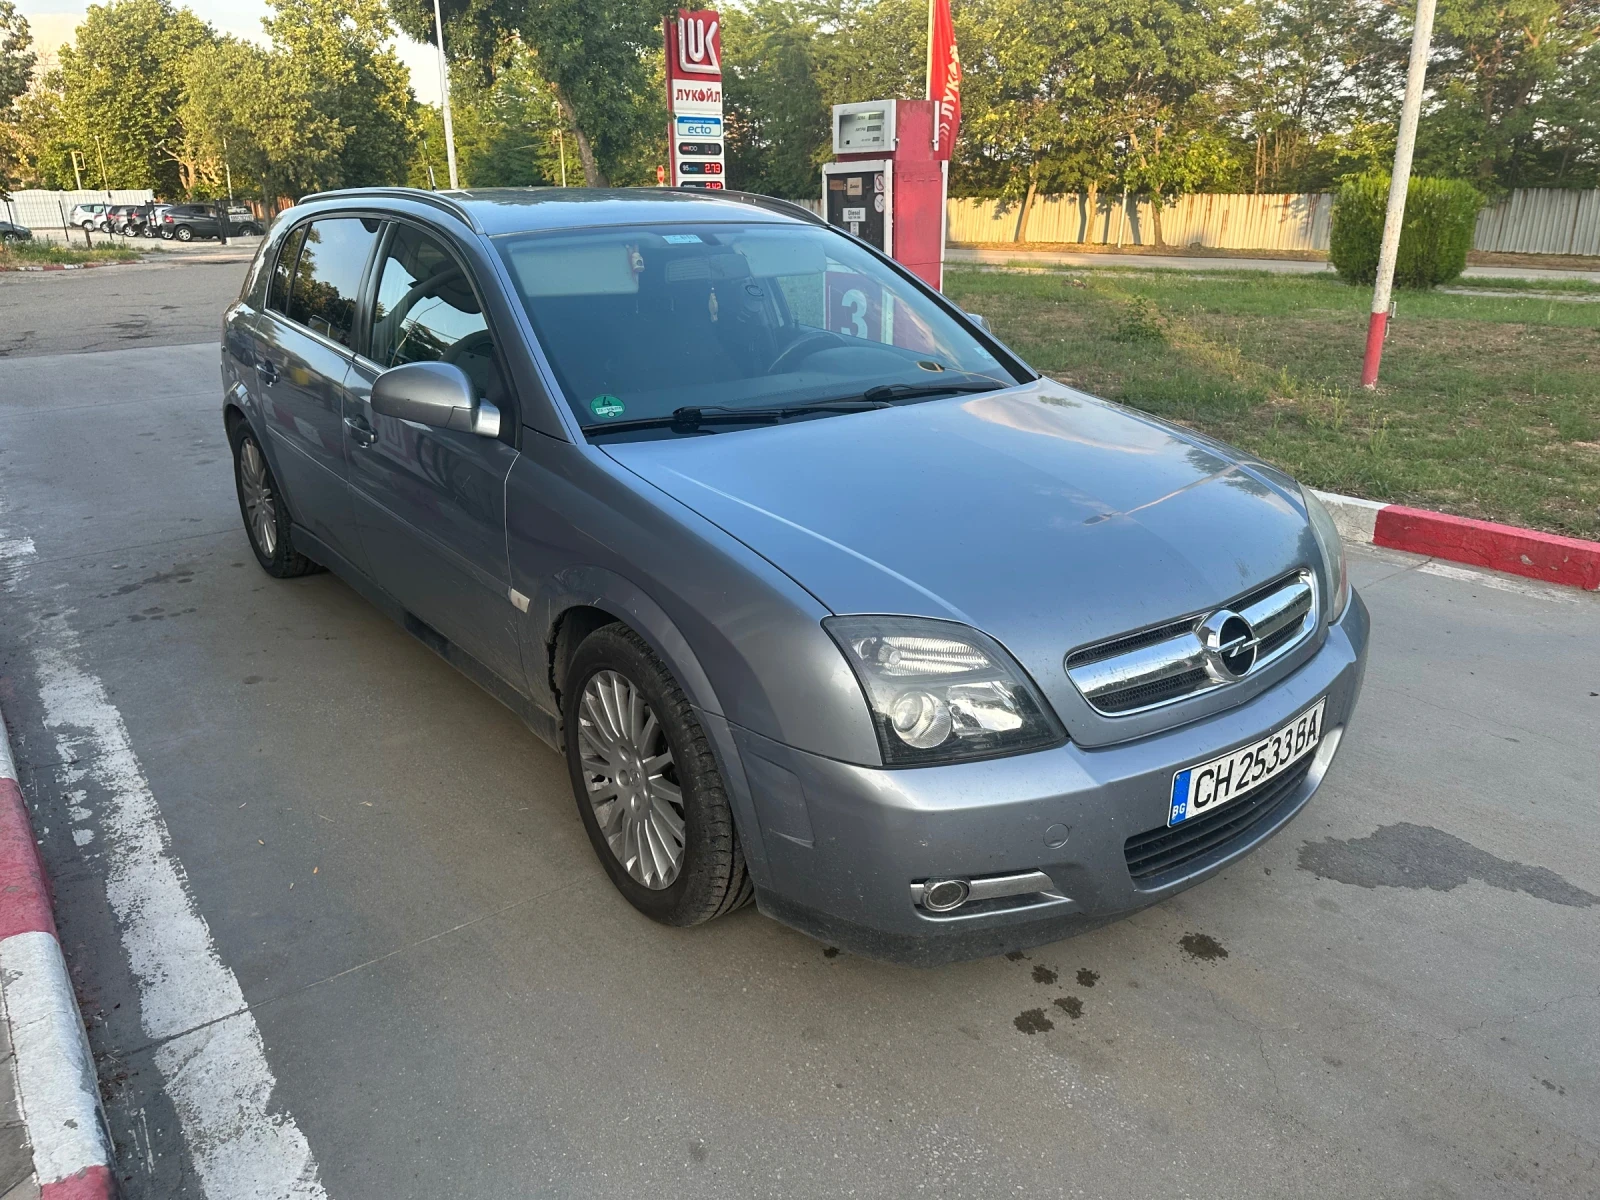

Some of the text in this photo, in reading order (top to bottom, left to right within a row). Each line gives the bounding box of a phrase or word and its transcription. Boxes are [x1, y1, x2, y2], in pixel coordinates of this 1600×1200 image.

[687, 125, 712, 135] ecto
[704, 163, 721, 173] 2.73
[841, 289, 868, 338] 3
[602, 396, 612, 406] 4
[1193, 708, 1318, 809] CH 2533 BA
[1172, 803, 1186, 817] BG
